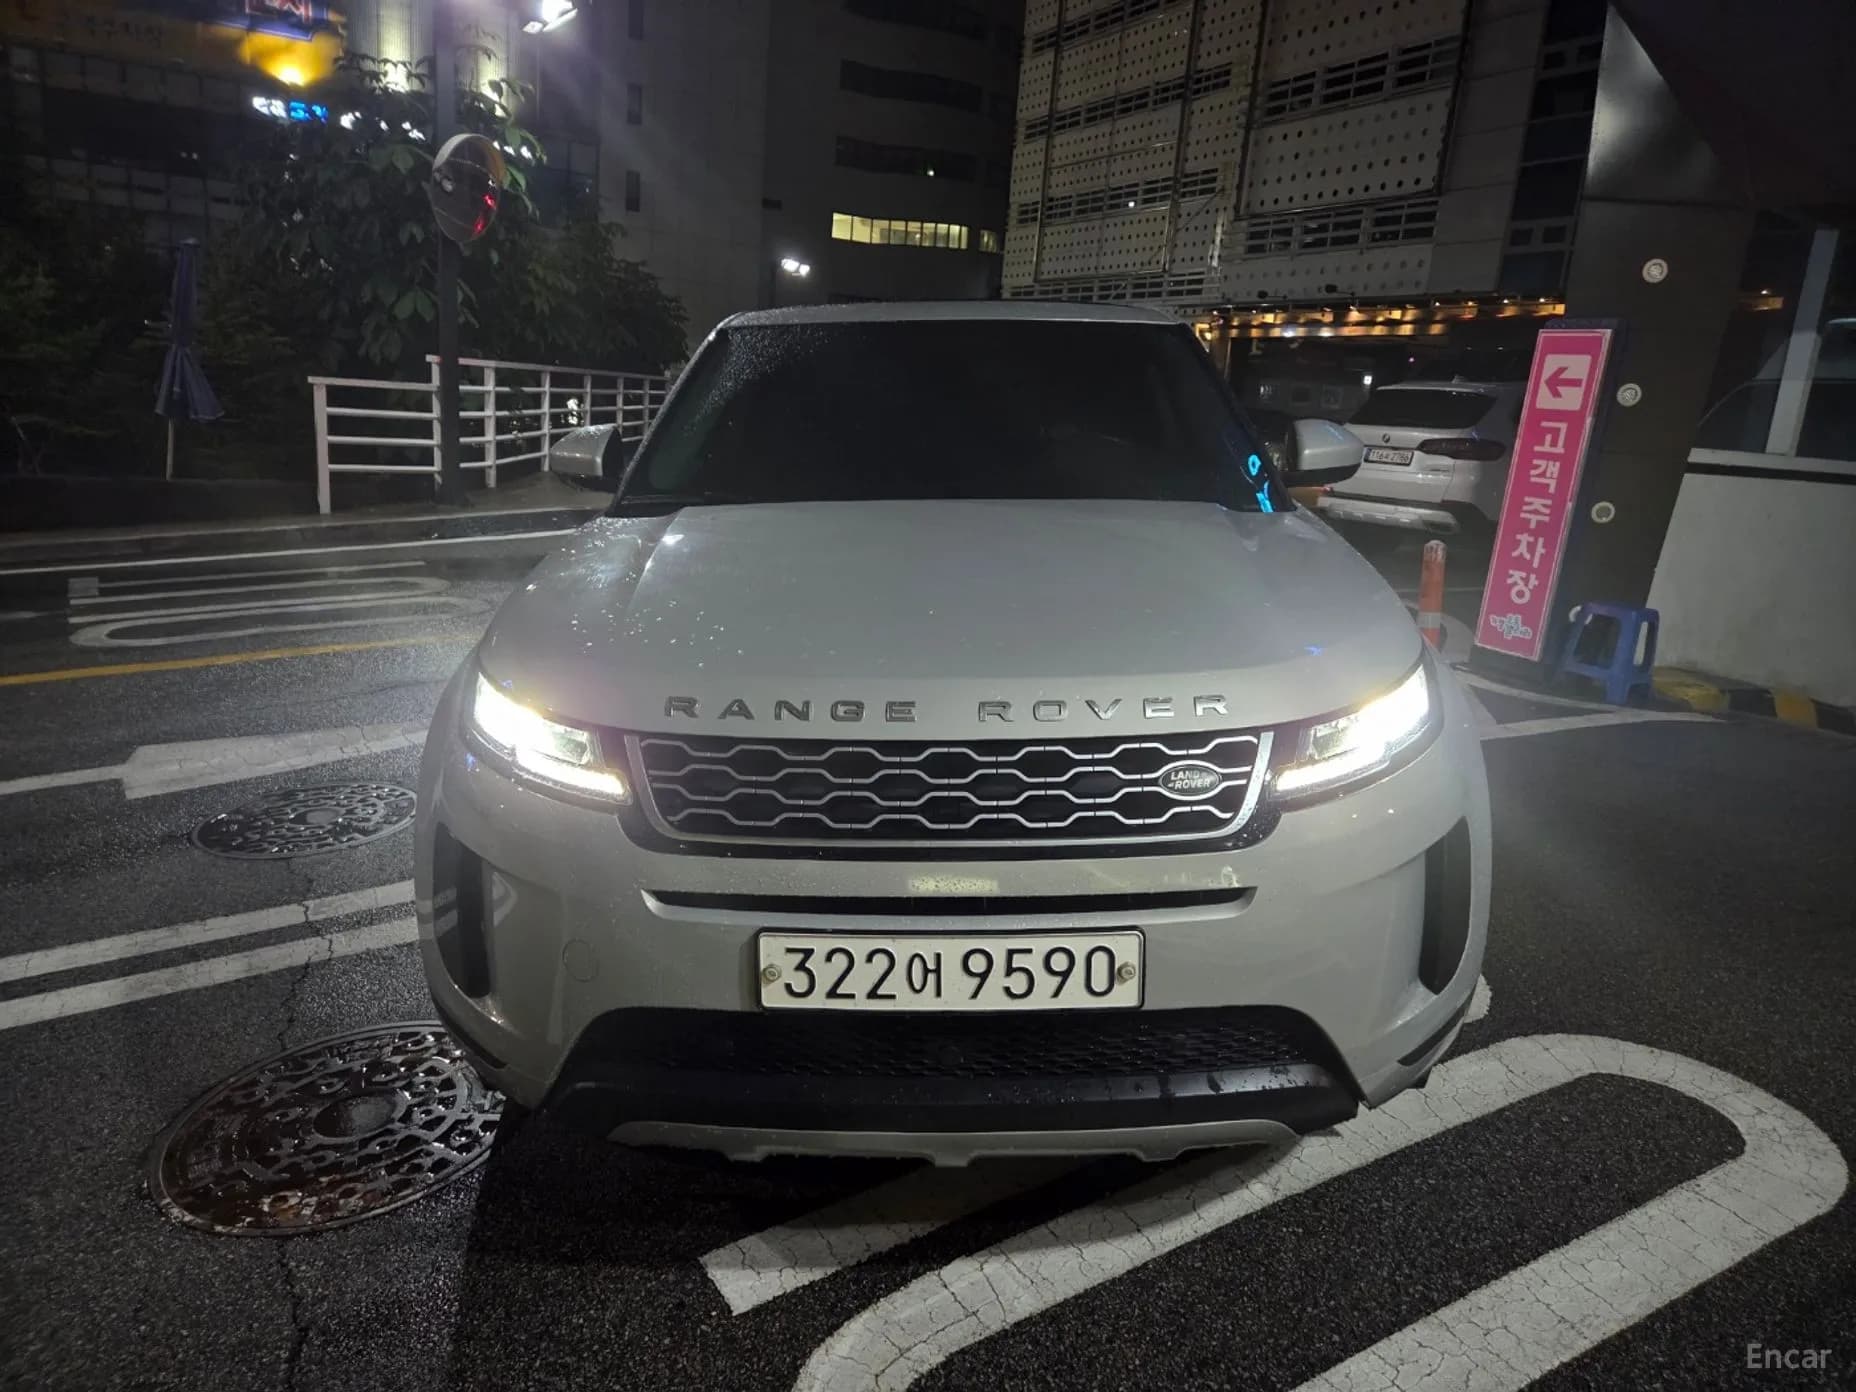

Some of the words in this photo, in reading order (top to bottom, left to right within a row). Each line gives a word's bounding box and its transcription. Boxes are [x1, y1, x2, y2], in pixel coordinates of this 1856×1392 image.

[664, 696, 917, 722] RANGE
[977, 694, 1229, 722] ROVER
[1170, 770, 1201, 781] LAND
[1174, 779, 1211, 790] ROVER
